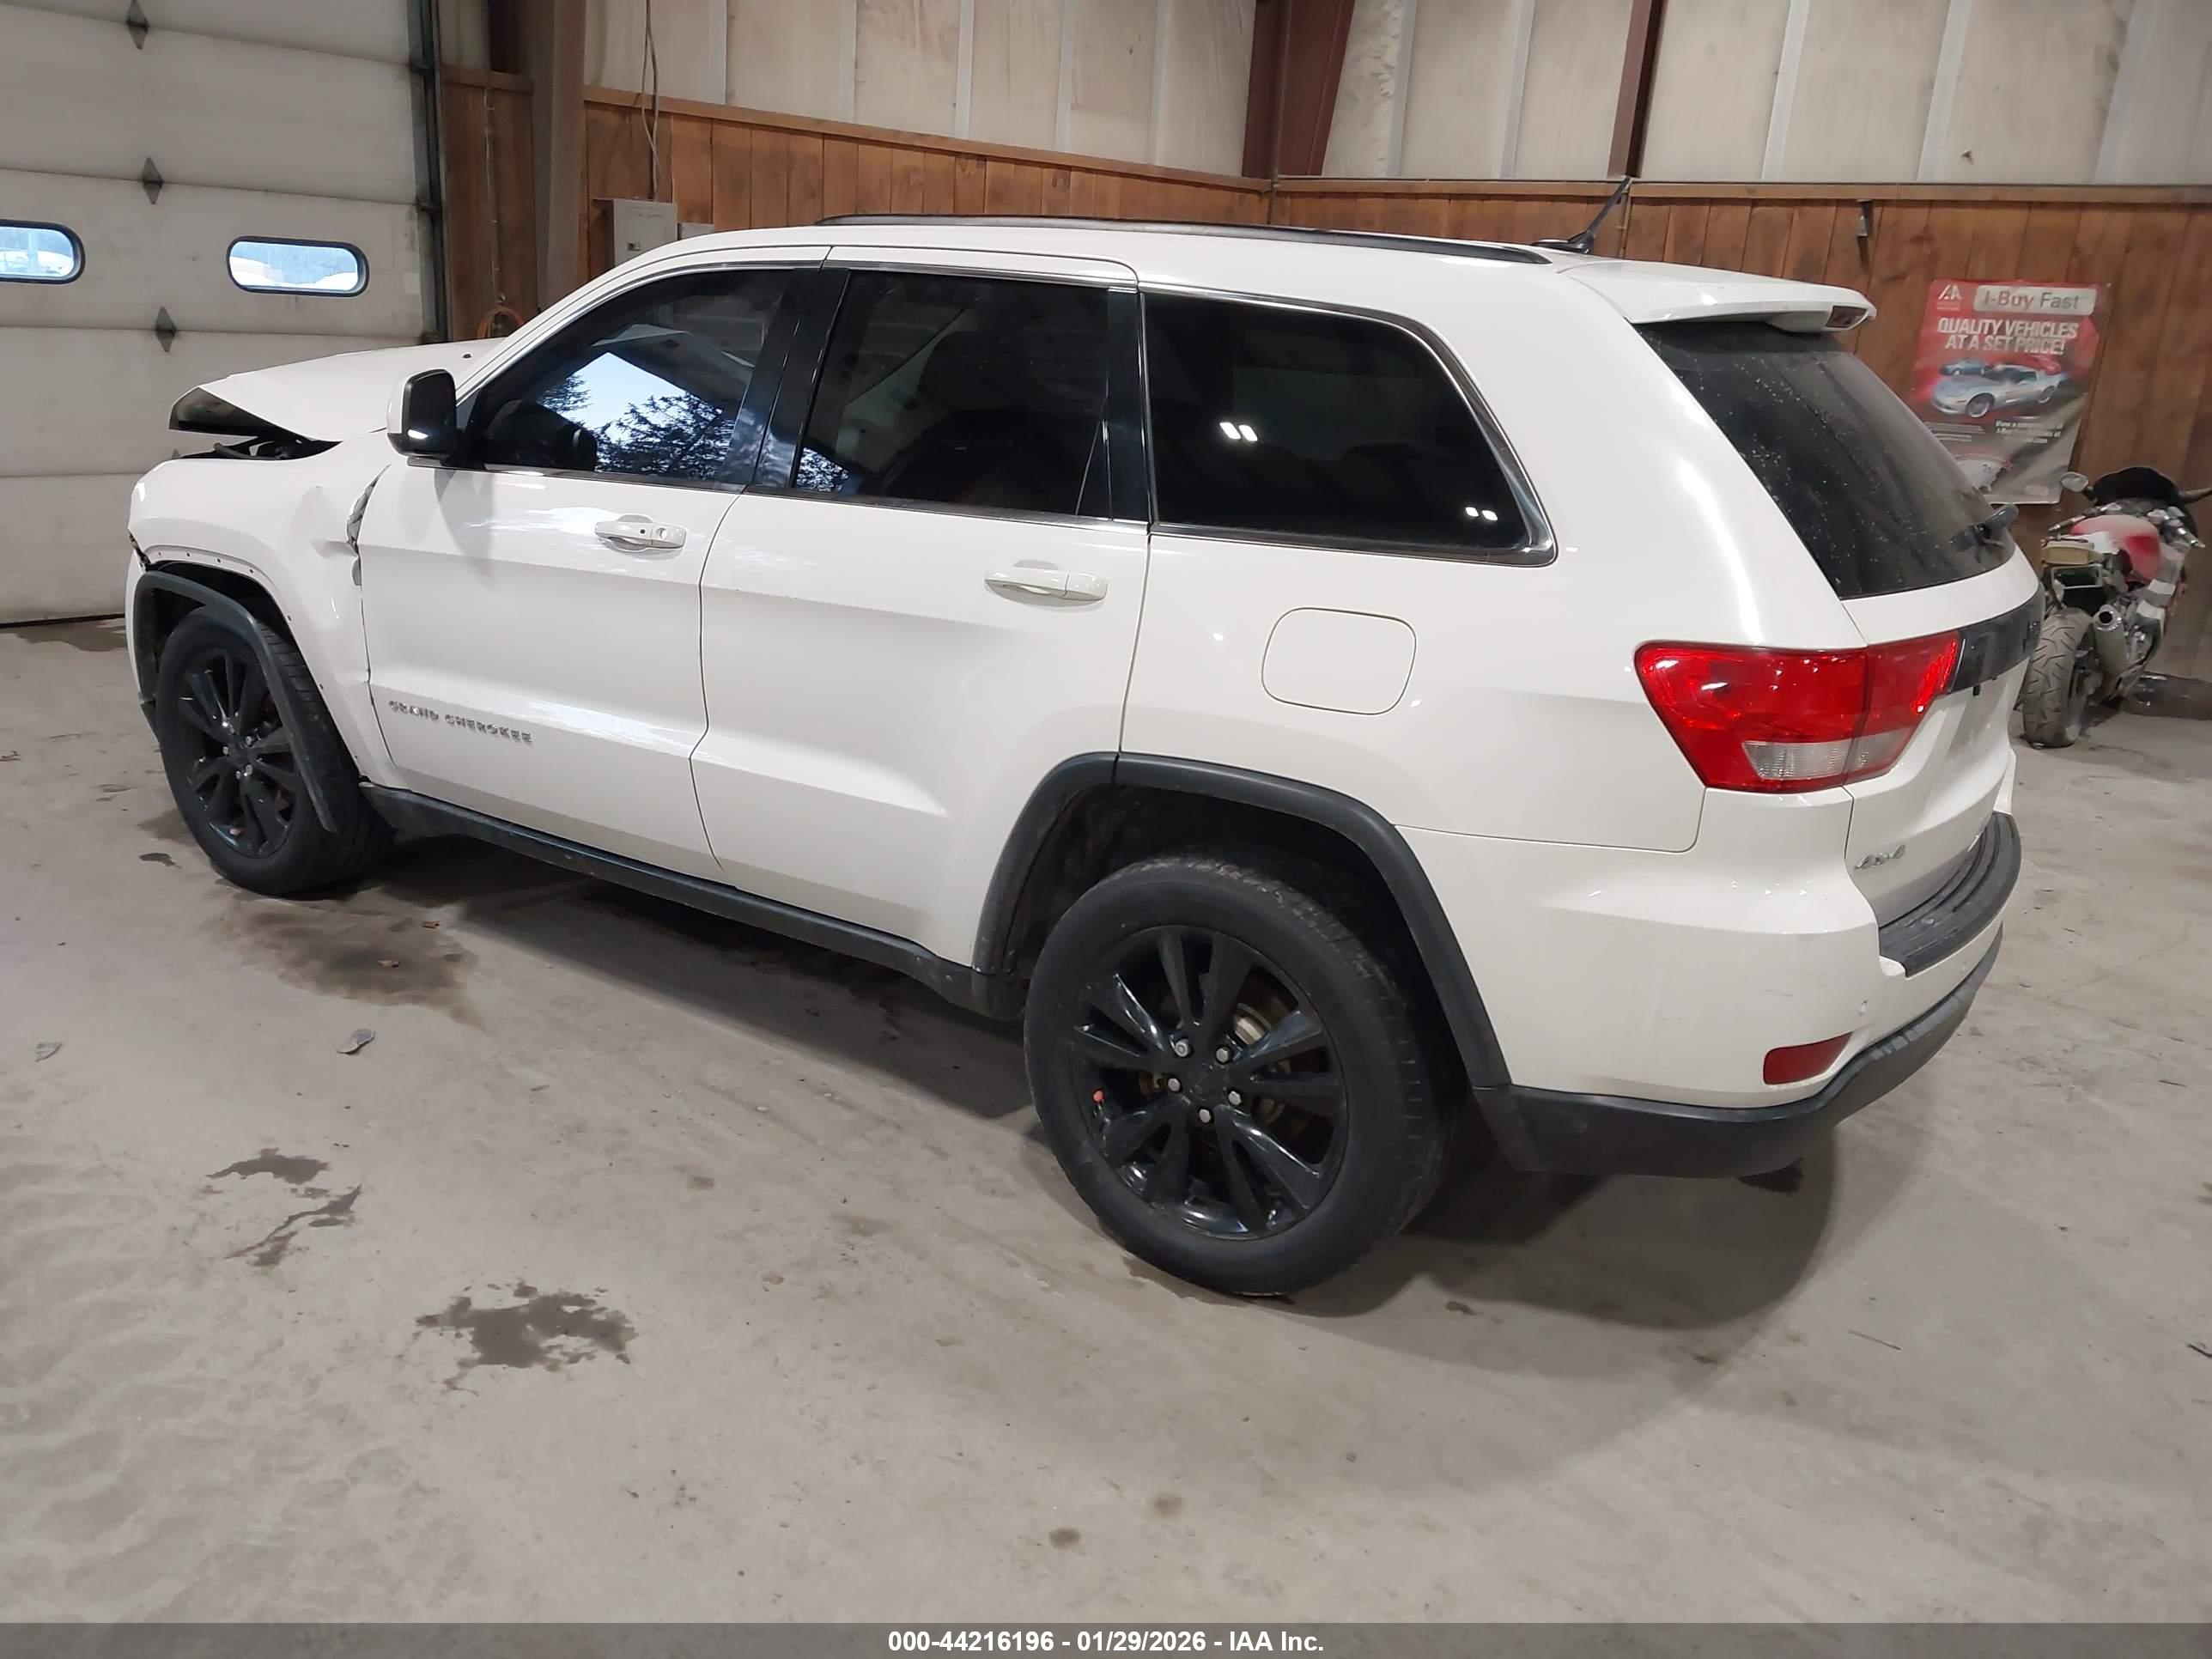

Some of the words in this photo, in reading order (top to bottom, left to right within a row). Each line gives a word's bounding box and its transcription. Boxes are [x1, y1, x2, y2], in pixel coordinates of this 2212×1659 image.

[1984, 290, 2034, 310] I-Buy
[2039, 291, 2079, 309] Fast
[1937, 317, 2003, 335] QUALITY
[2005, 319, 2079, 339] VEHICLES
[1945, 334, 1968, 349] AT
[1968, 335, 1979, 350] A
[1983, 335, 2013, 352] SET
[2014, 337, 2067, 356] PRICE!
[389, 700, 440, 721] GRAND
[445, 714, 532, 744] CHEROKEE
